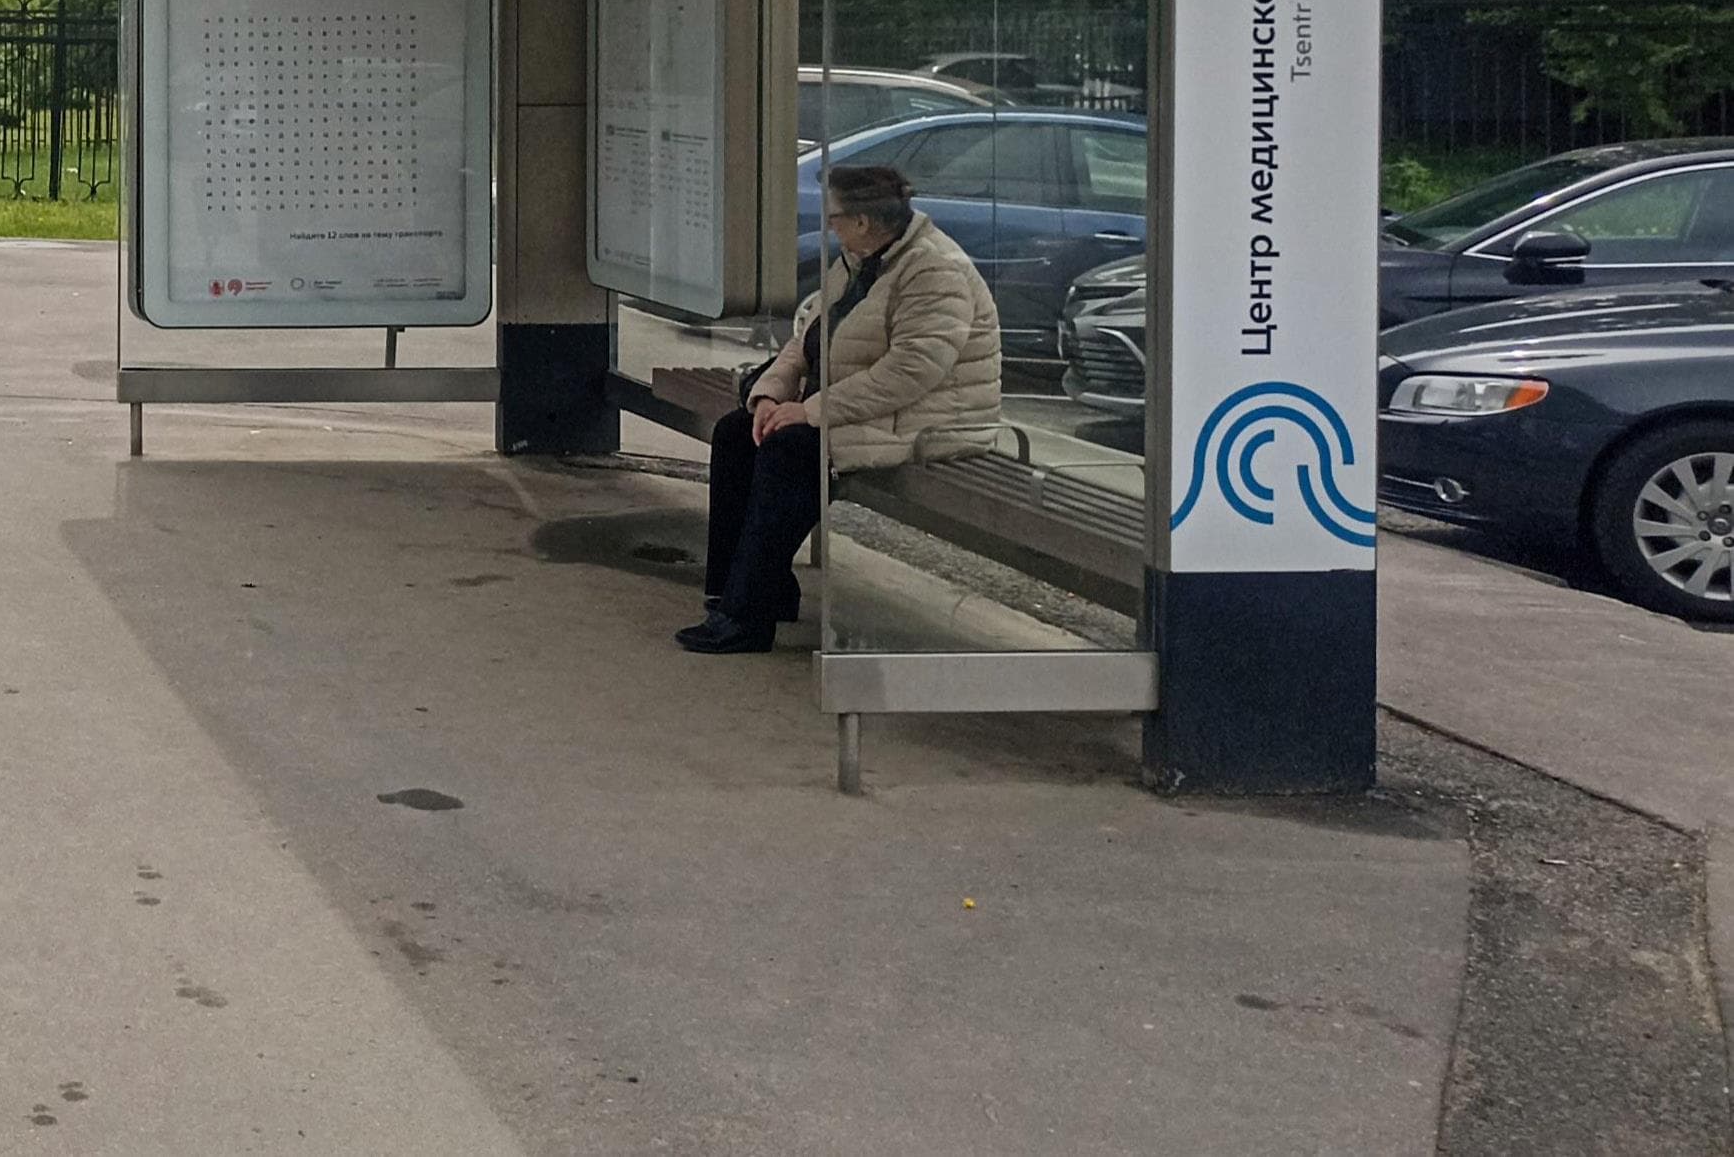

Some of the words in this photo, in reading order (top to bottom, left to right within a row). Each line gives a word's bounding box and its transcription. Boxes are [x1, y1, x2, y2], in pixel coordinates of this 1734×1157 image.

[1291, 3, 1312, 82] Tsentr
[327, 231, 338, 239] 12
[1241, 234, 1280, 355] Центр
